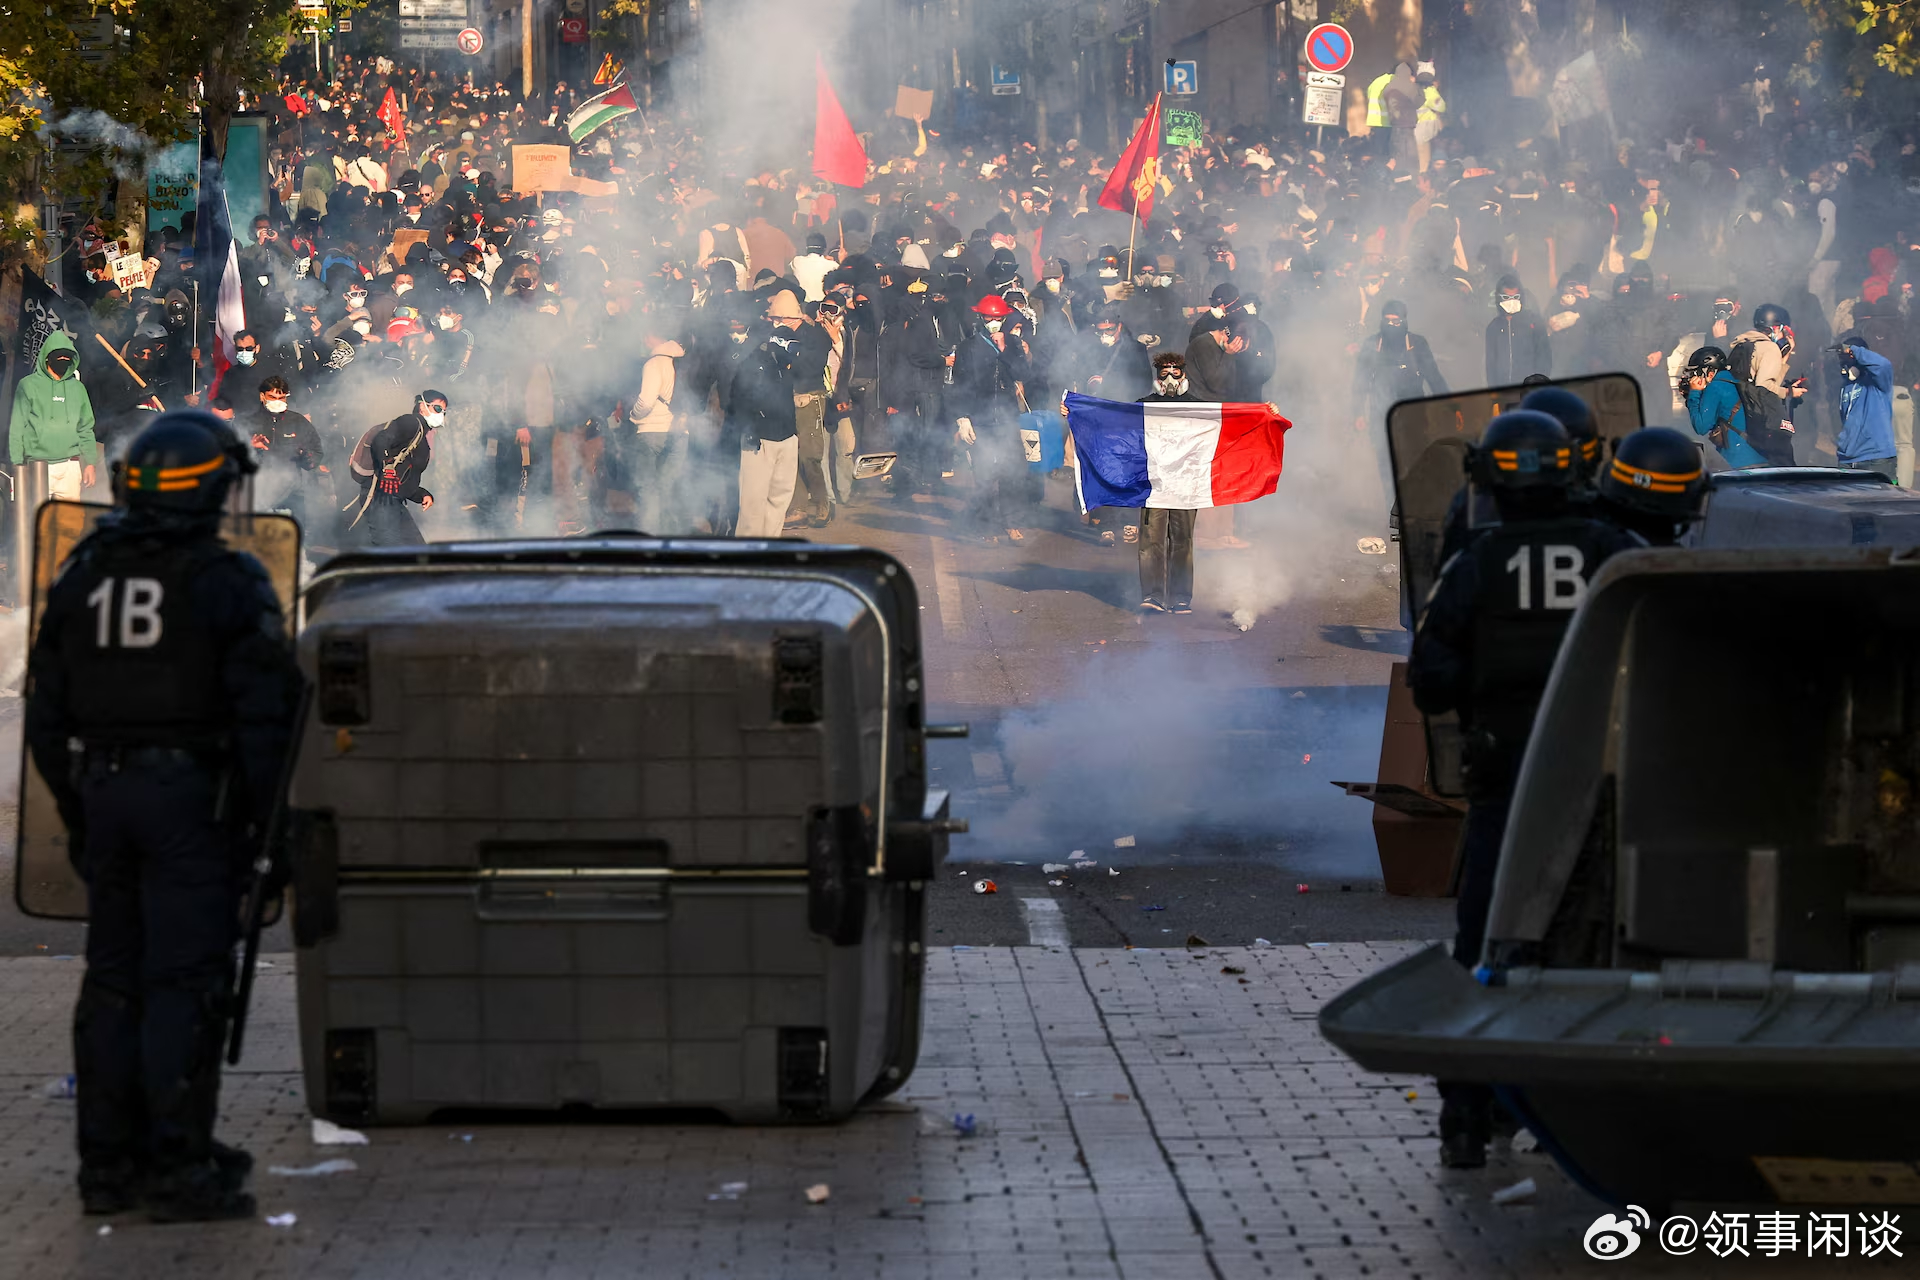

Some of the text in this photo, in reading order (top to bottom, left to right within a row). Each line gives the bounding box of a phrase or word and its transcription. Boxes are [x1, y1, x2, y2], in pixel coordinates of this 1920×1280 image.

[567, 20, 582, 33] Q
[1174, 68, 1188, 84] P
[116, 262, 123, 271] LE
[120, 271, 143, 288] PEUPLE
[1506, 544, 1589, 610] 1B
[87, 577, 163, 648] 1B
